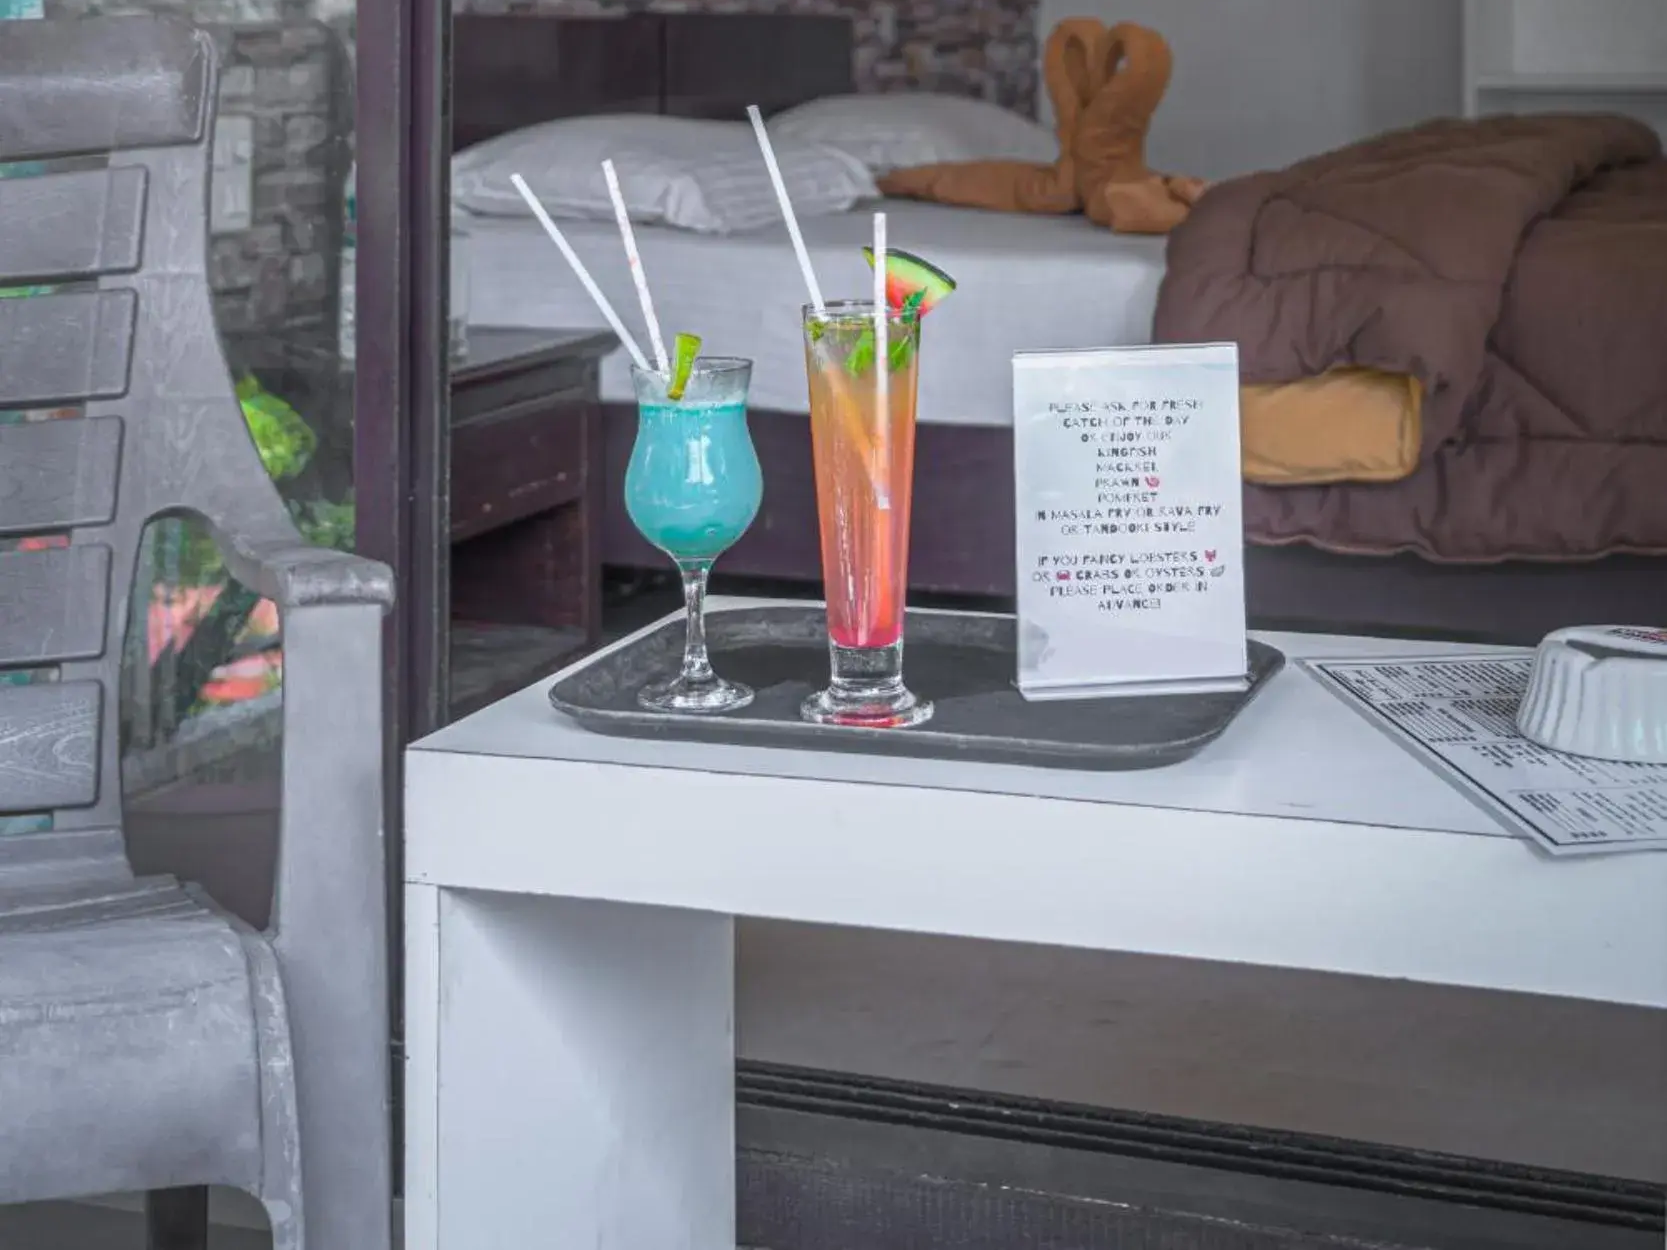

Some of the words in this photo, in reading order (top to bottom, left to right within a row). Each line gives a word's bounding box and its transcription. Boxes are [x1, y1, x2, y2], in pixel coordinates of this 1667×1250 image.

[1063, 417, 1108, 428] CATCH
[1113, 417, 1130, 427] OF
[1165, 415, 1189, 425] DAY
[1097, 446, 1157, 457] KINGFISH
[1098, 492, 1158, 503] POMFRET
[1051, 509, 1104, 520] MASALA
[1108, 507, 1130, 518] FRY
[1136, 506, 1153, 517] OR
[1197, 505, 1221, 516] FRY
[1084, 523, 1150, 535] TANDOORI
[1154, 521, 1196, 533] STYLE
[1038, 555, 1048, 566] IF
[1053, 555, 1078, 566] YOU
[1083, 553, 1125, 565] FANCY
[1130, 551, 1198, 563] LOBSTERS
[1076, 569, 1119, 581] CRABS
[1145, 566, 1205, 578] OYSTERS
[1050, 584, 1097, 596] PLEASE
[1102, 583, 1143, 595] PLACE
[1148, 582, 1190, 594] ORDER
[1195, 581, 1208, 592] IN
